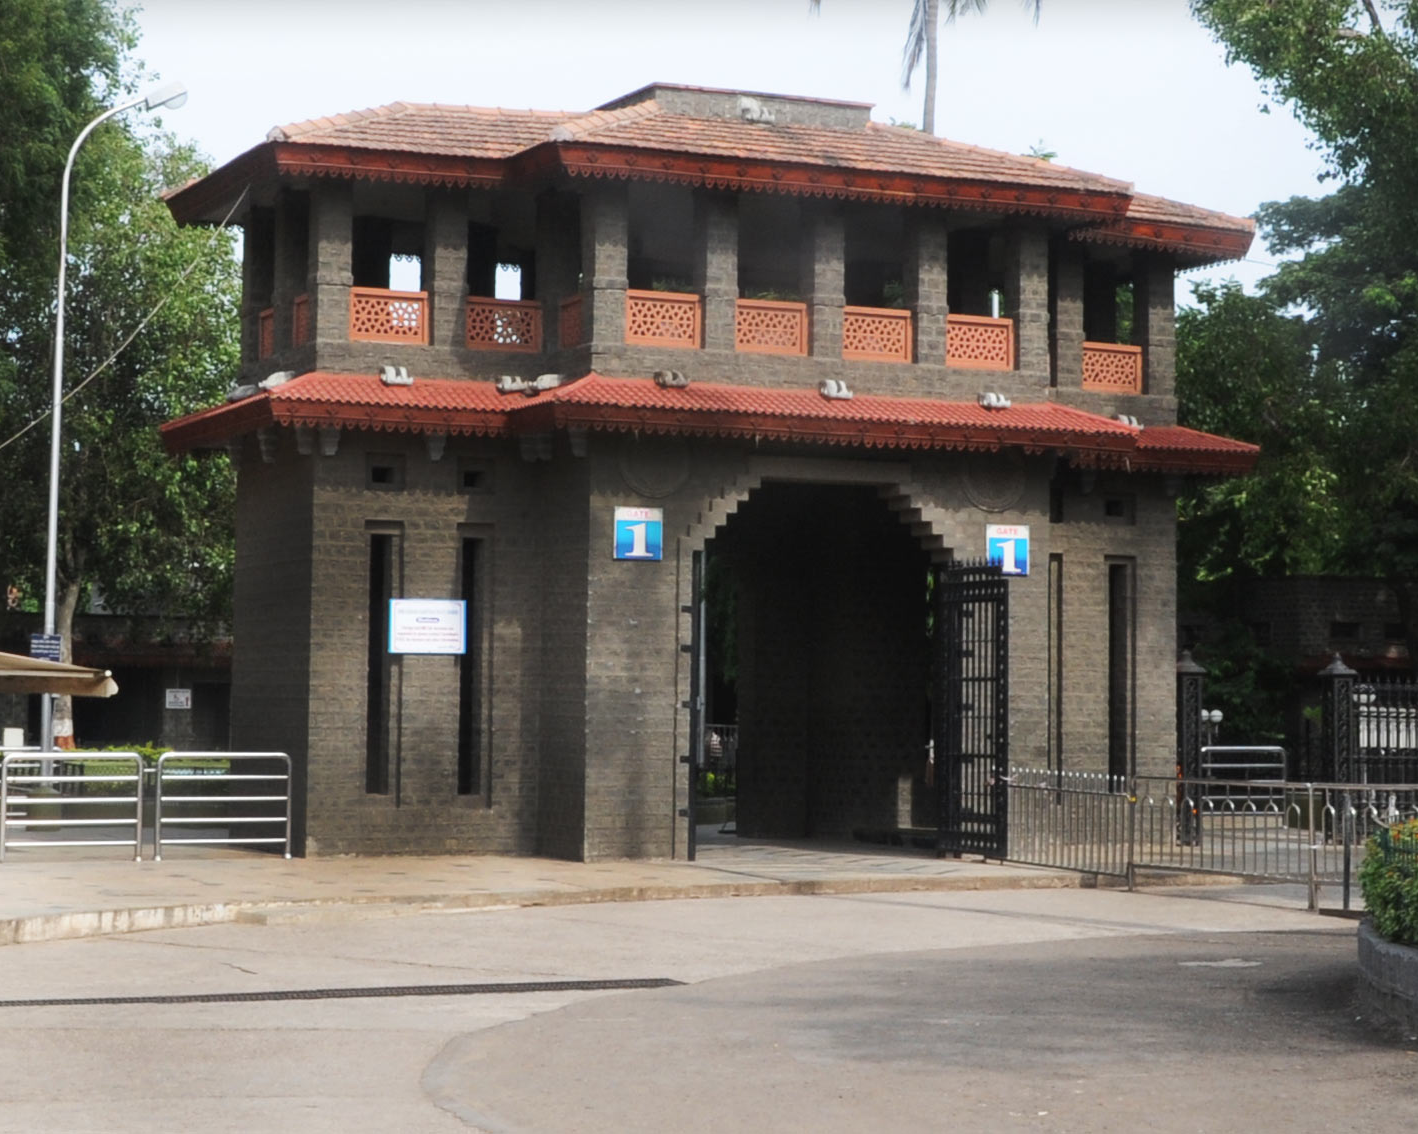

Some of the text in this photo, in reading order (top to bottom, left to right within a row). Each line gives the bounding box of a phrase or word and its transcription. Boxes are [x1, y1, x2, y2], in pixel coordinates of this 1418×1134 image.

[626, 510, 650, 518] GATE
[624, 522, 654, 557] 1
[996, 539, 1022, 573] 1
